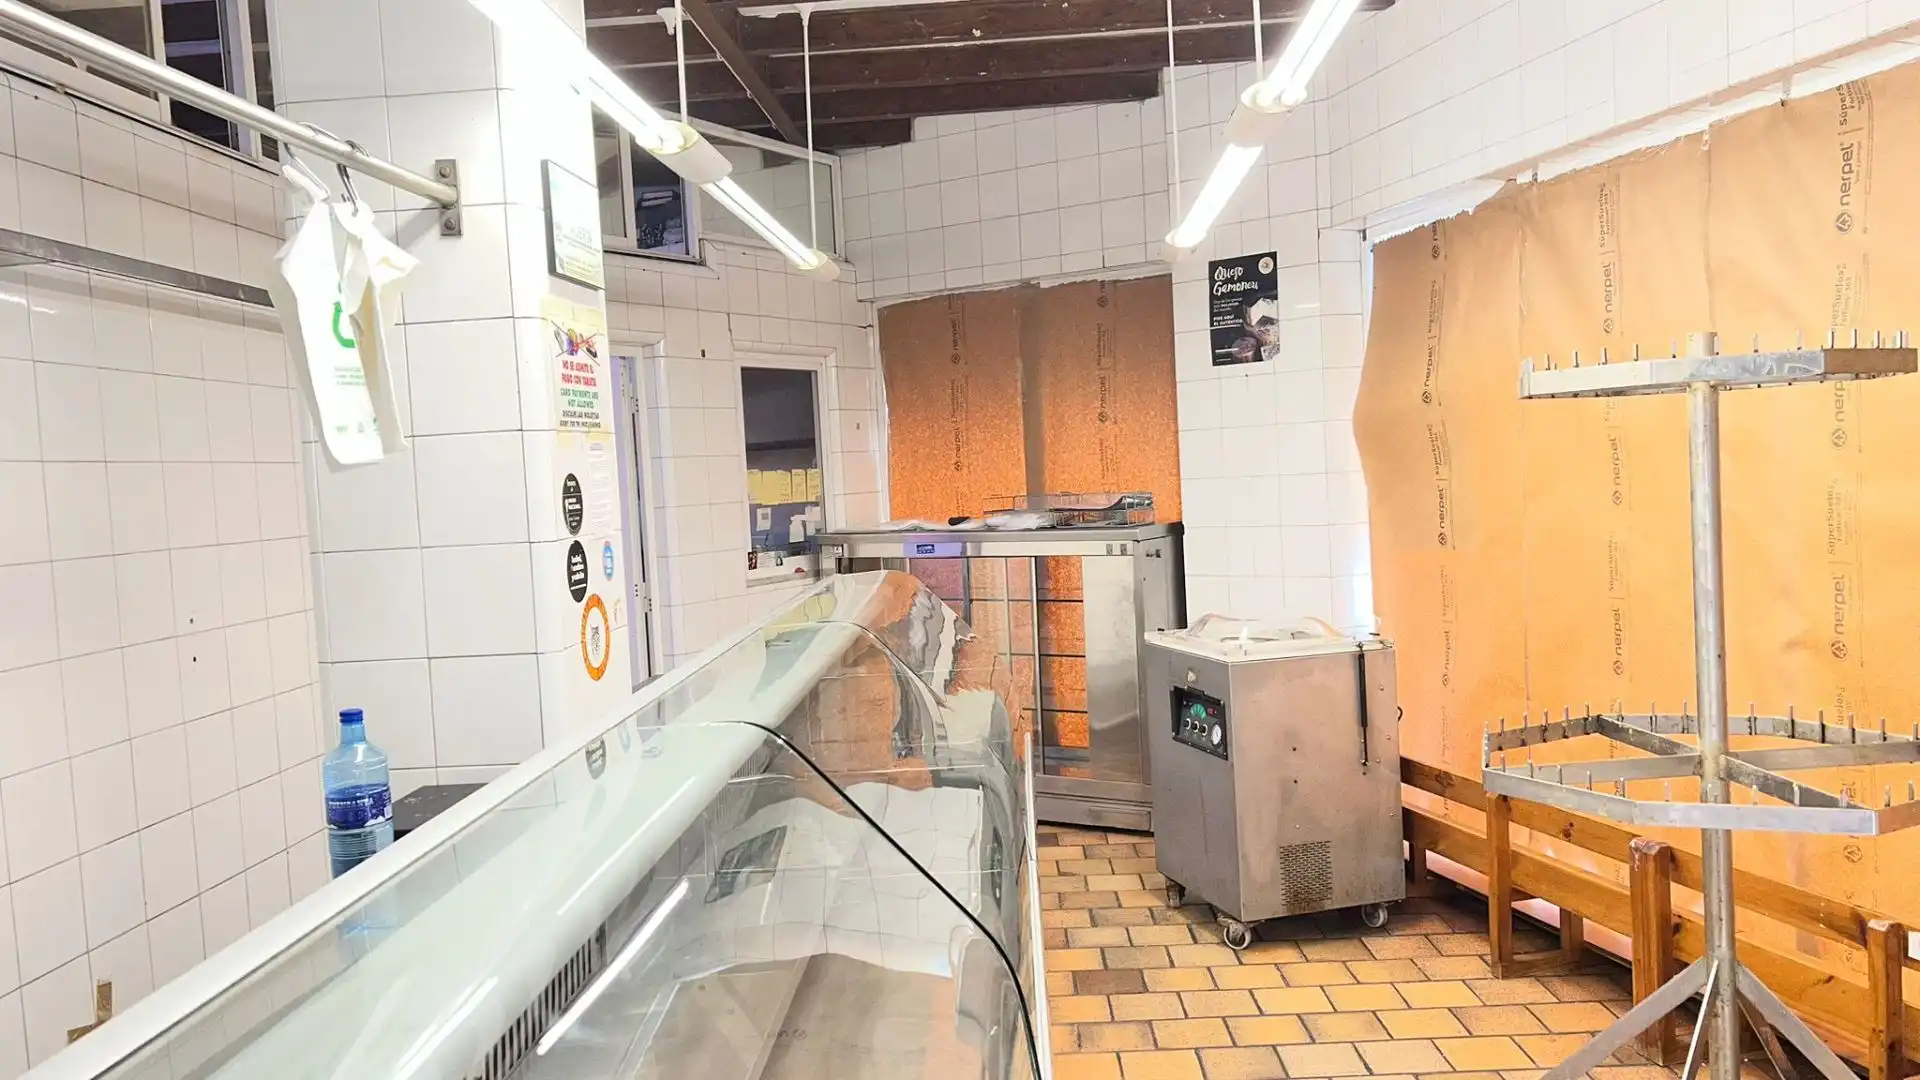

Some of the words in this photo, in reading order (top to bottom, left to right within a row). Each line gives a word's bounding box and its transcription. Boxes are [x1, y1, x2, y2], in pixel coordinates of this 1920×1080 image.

[1839, 142, 1854, 206] nerpel
[1214, 265, 1244, 281] Queso
[1603, 261, 1613, 313] nerpel
[1424, 344, 1433, 387] nerpel
[1834, 380, 1846, 422] nerp
[1609, 434, 1621, 486] nerpel
[1437, 486, 1445, 529] nerpel
[1833, 573, 1847, 635] nerpel
[1613, 607, 1622, 657] nerpel
